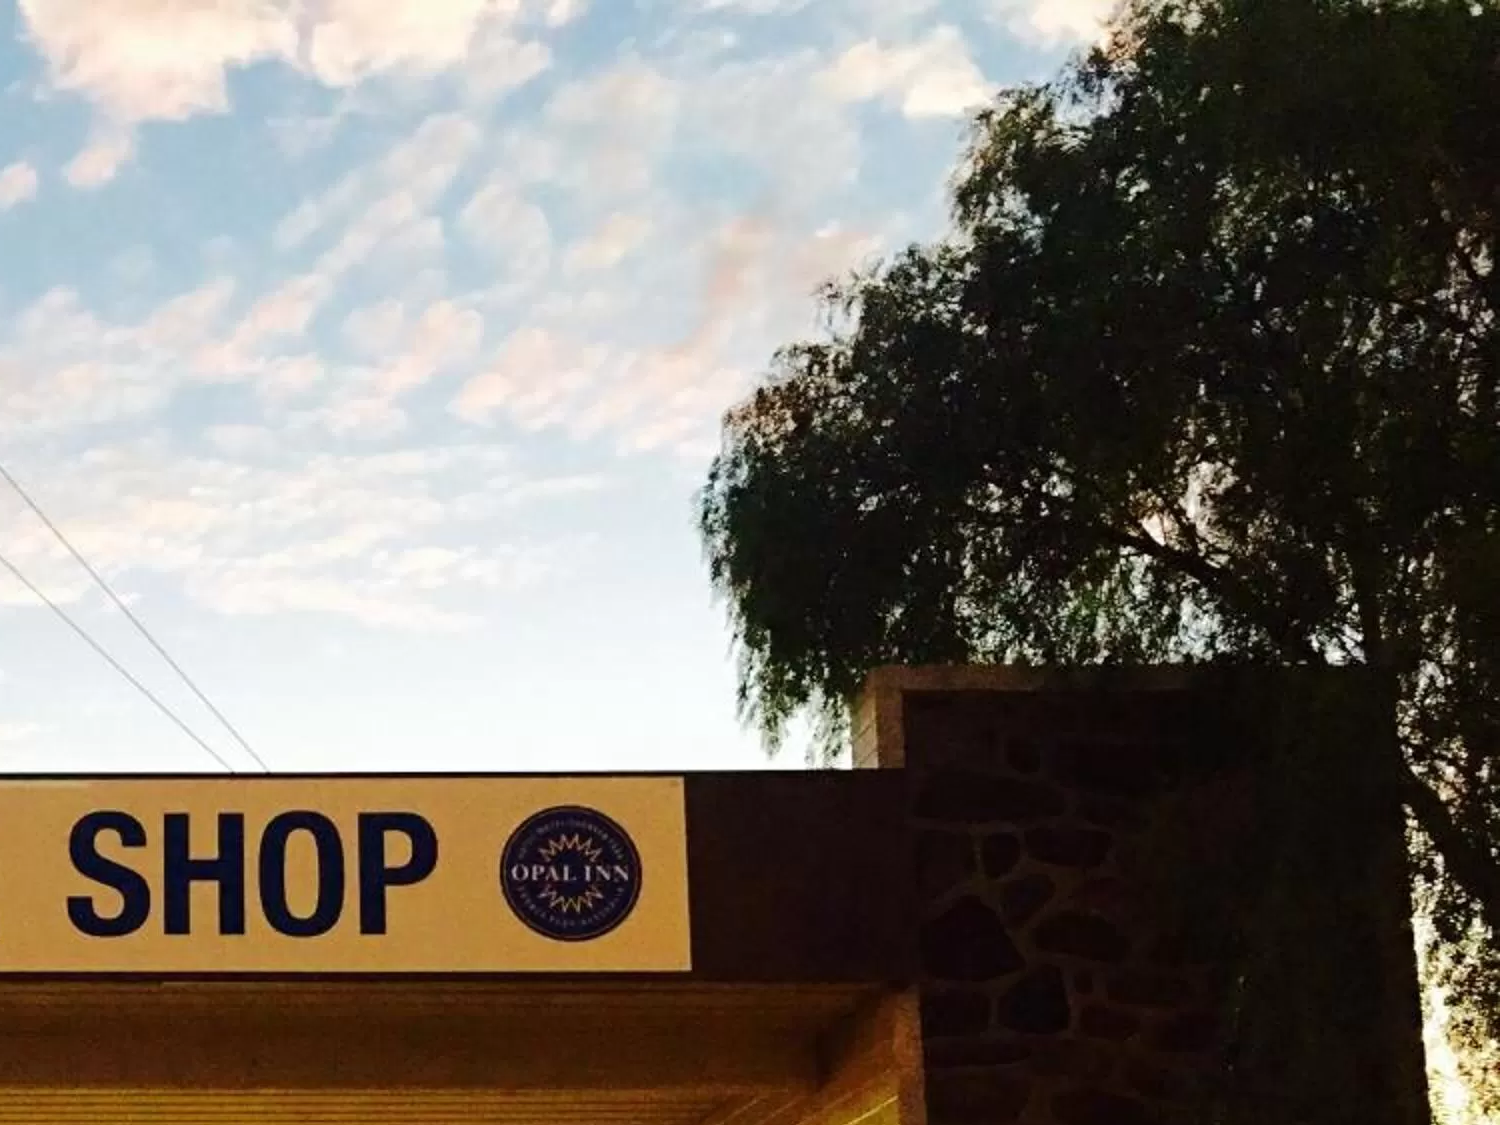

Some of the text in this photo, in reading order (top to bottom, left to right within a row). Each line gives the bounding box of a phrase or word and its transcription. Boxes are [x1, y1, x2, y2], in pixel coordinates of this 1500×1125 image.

[67, 811, 437, 937] SHOP
[510, 864, 629, 882] OPAL INN
